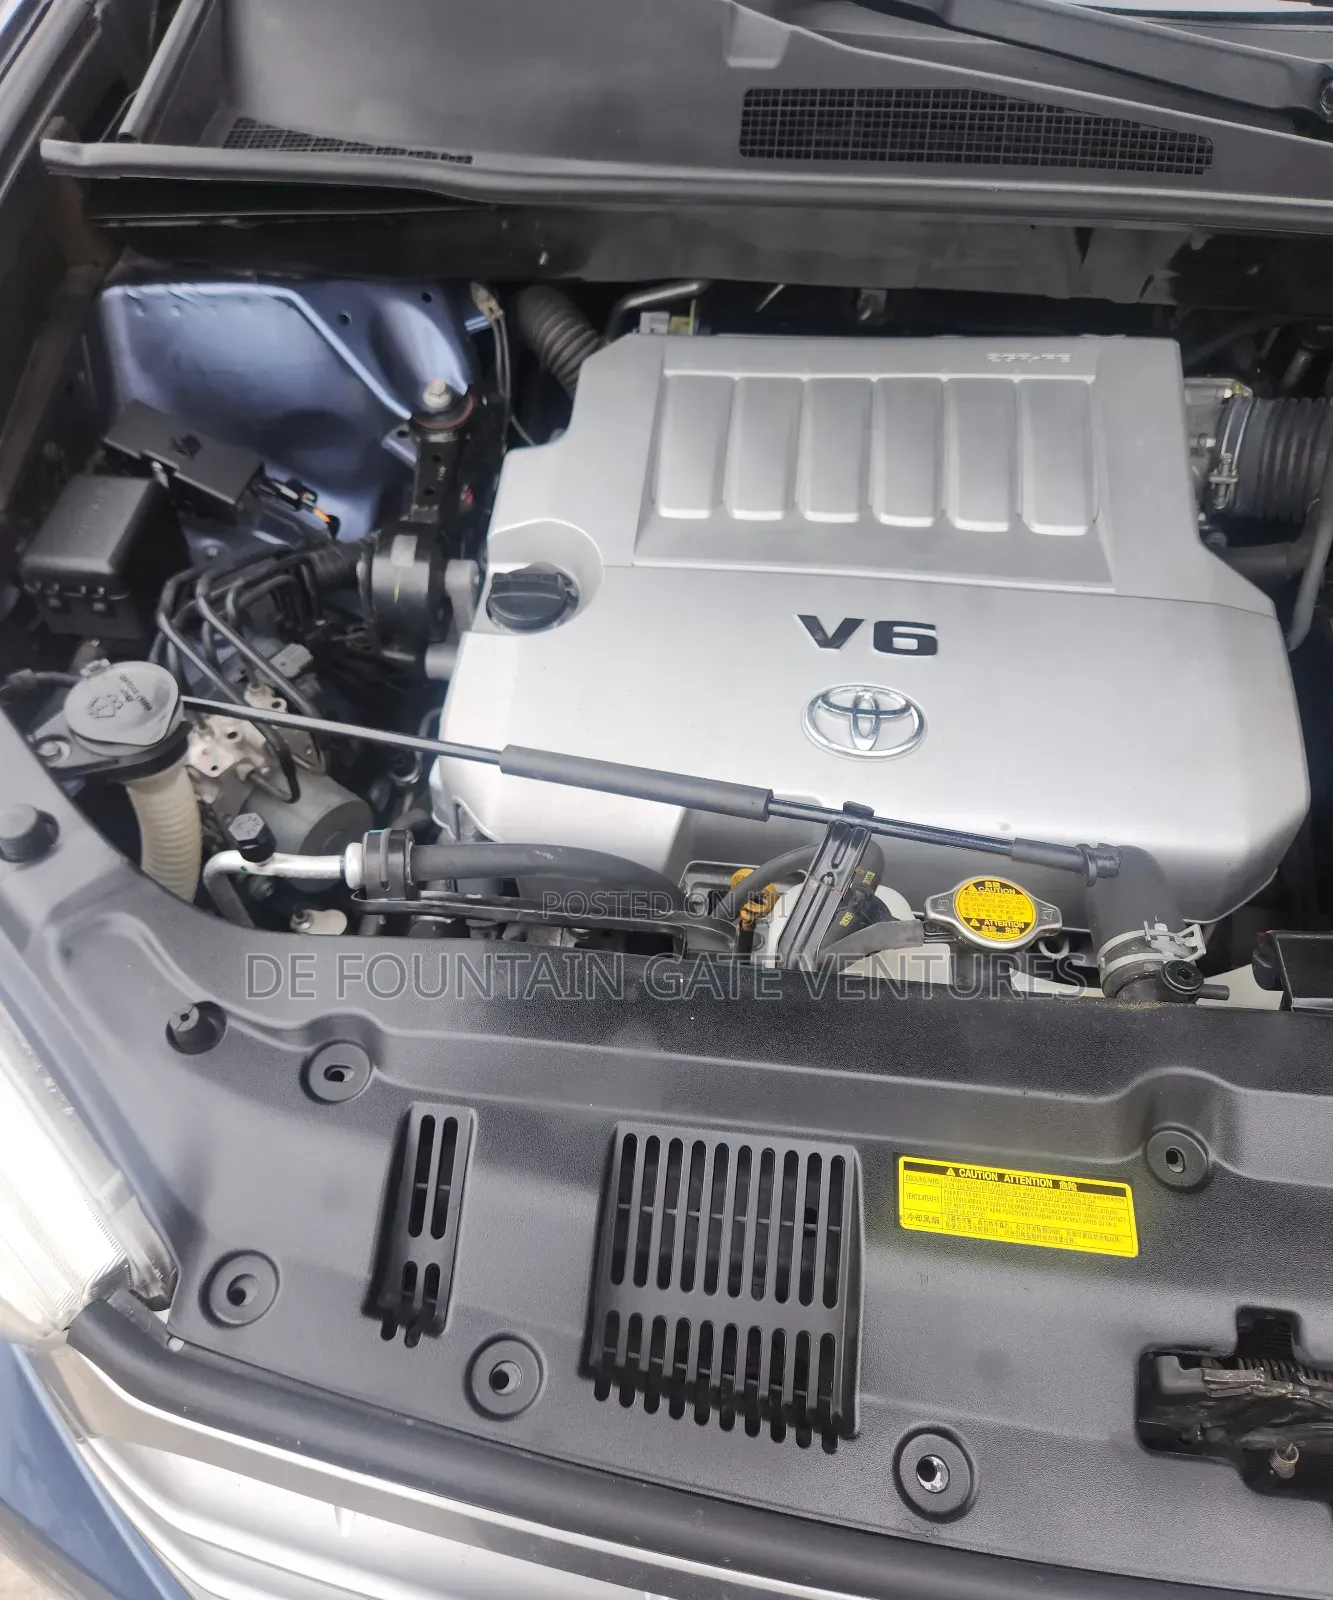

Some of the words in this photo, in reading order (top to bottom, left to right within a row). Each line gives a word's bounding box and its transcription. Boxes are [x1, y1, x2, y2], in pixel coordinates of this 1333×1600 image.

[794, 614, 938, 657] V6
[984, 919, 1025, 929] ATTENTION
[959, 1168, 997, 1181] CAUTION
[1004, 1174, 1052, 1188] ATTENTION
[905, 1192, 939, 1202] VENTILATEURS
